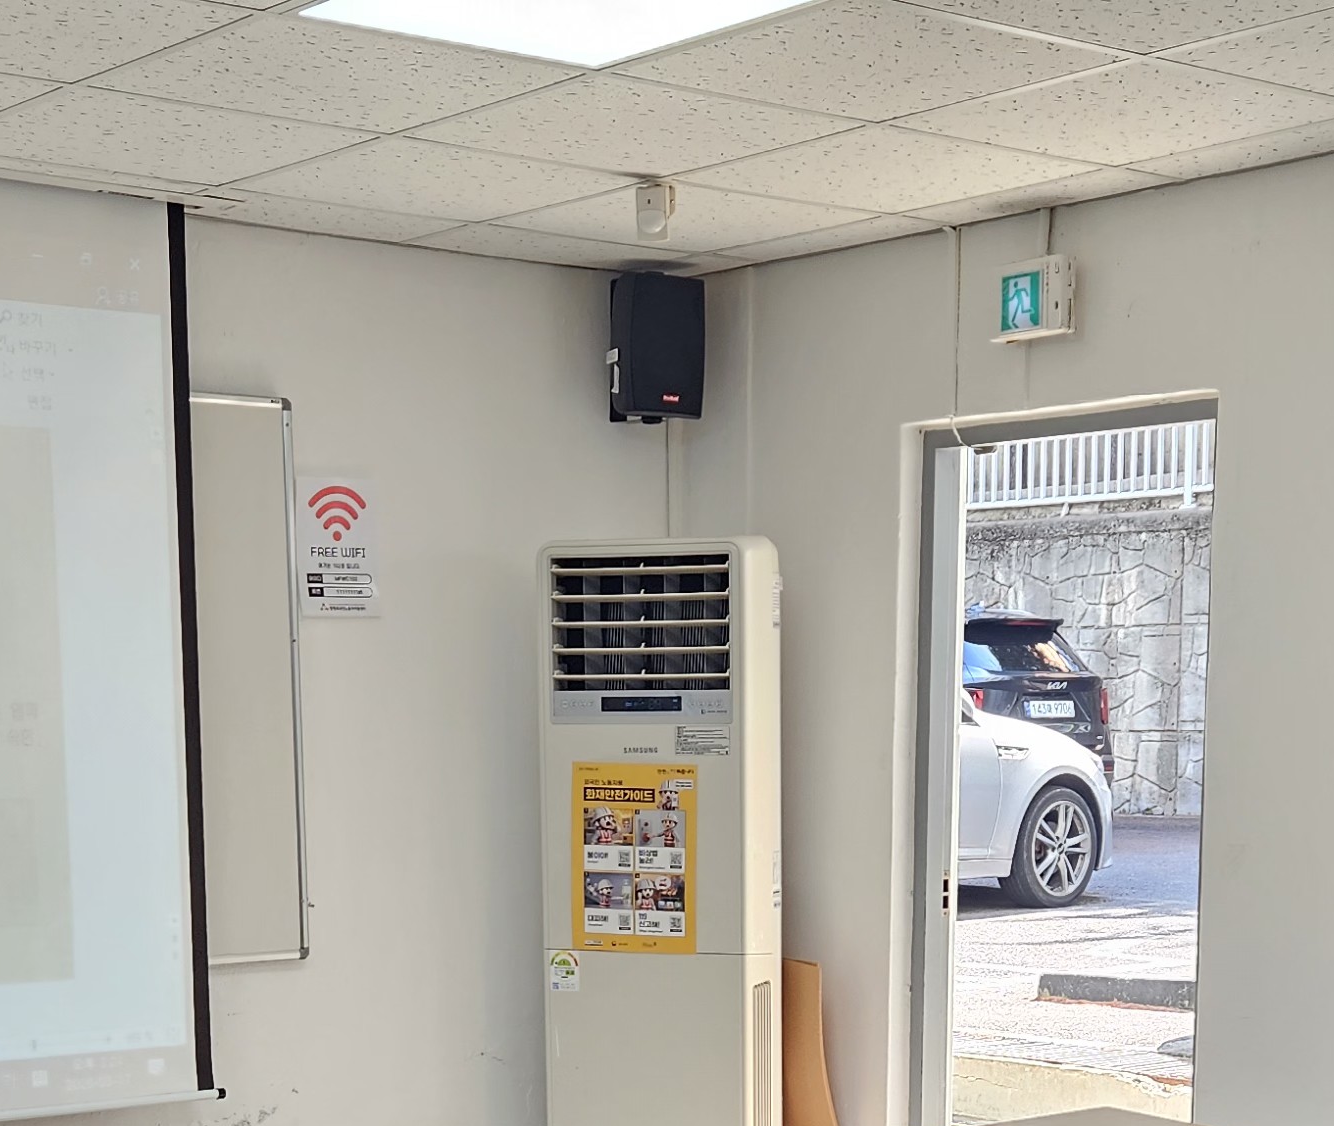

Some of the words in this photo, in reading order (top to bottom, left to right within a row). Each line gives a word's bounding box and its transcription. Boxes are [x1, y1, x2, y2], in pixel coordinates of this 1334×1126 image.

[17, 310, 43, 328] 찾기
[19, 340, 58, 358] 바꾸기
[310, 546, 338, 558] FREE
[340, 547, 366, 558] WIFI
[623, 746, 659, 754] SAMSUNG
[585, 788, 654, 802] 화재안전가이드
